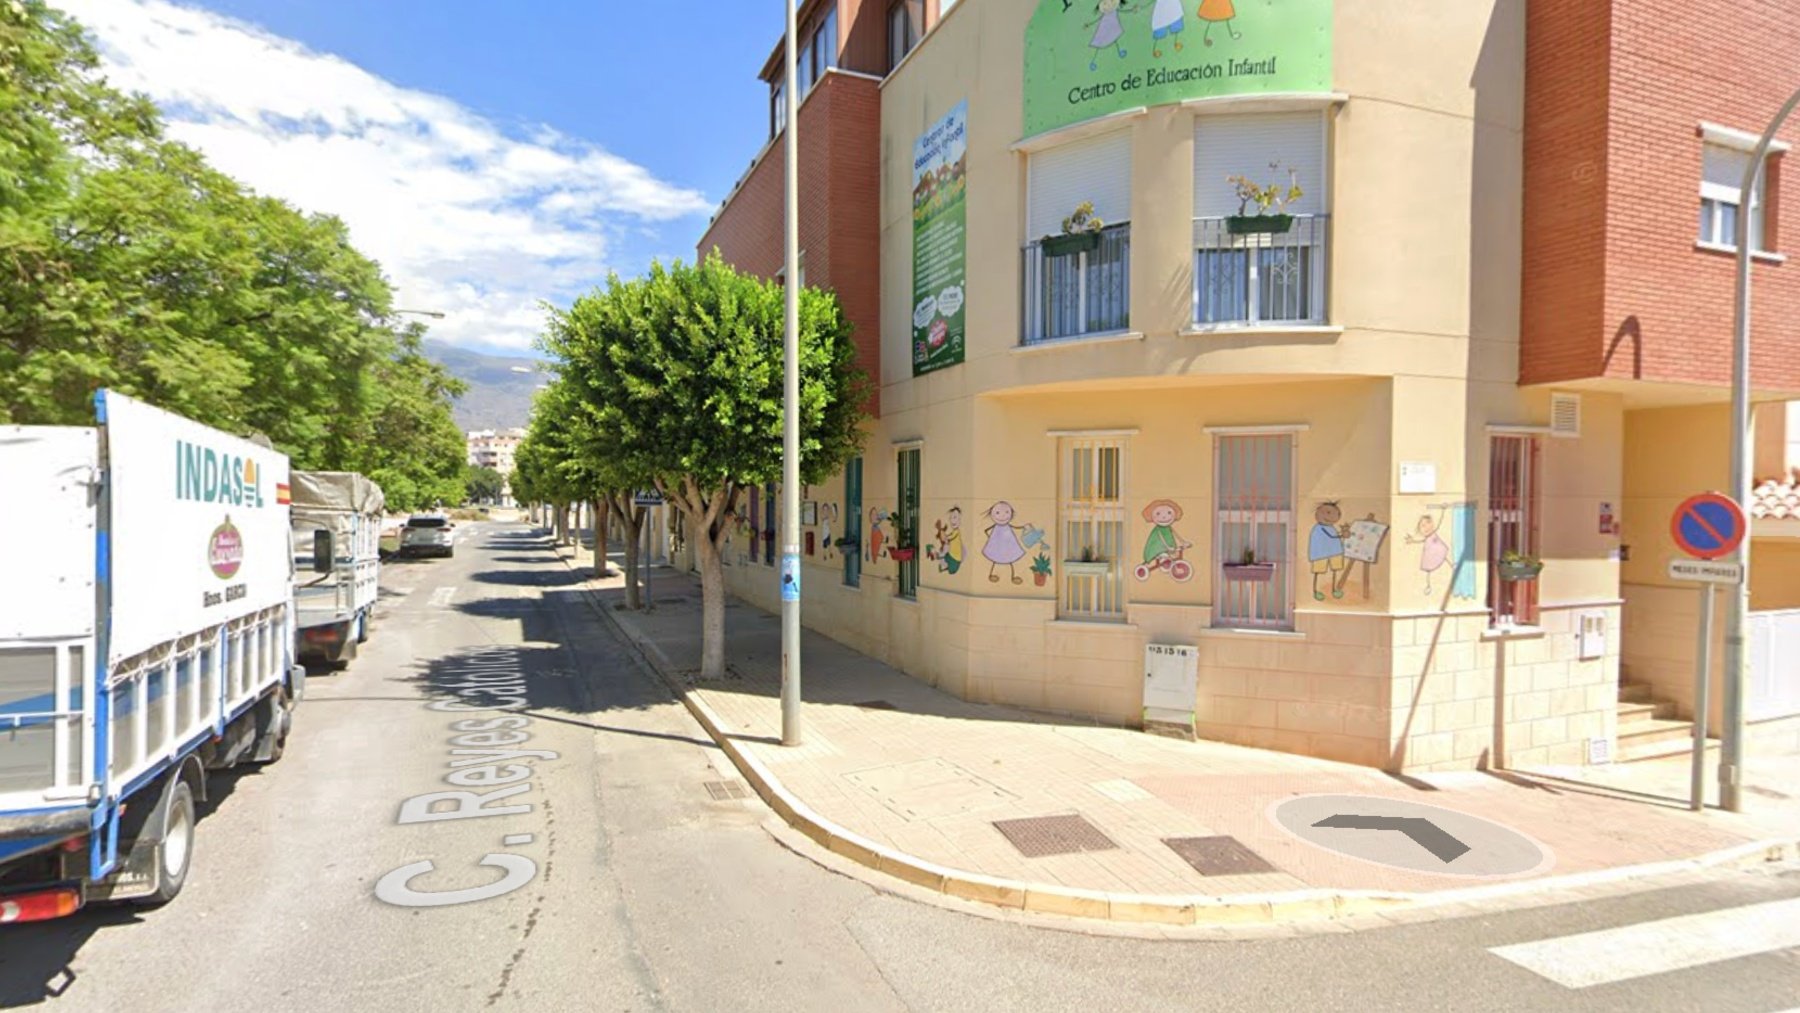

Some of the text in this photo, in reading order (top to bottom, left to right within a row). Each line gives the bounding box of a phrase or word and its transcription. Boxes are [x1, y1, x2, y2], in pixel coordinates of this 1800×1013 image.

[1068, 56, 1277, 105] Centro de Educación Infantil
[176, 439, 264, 508] INDASOL
